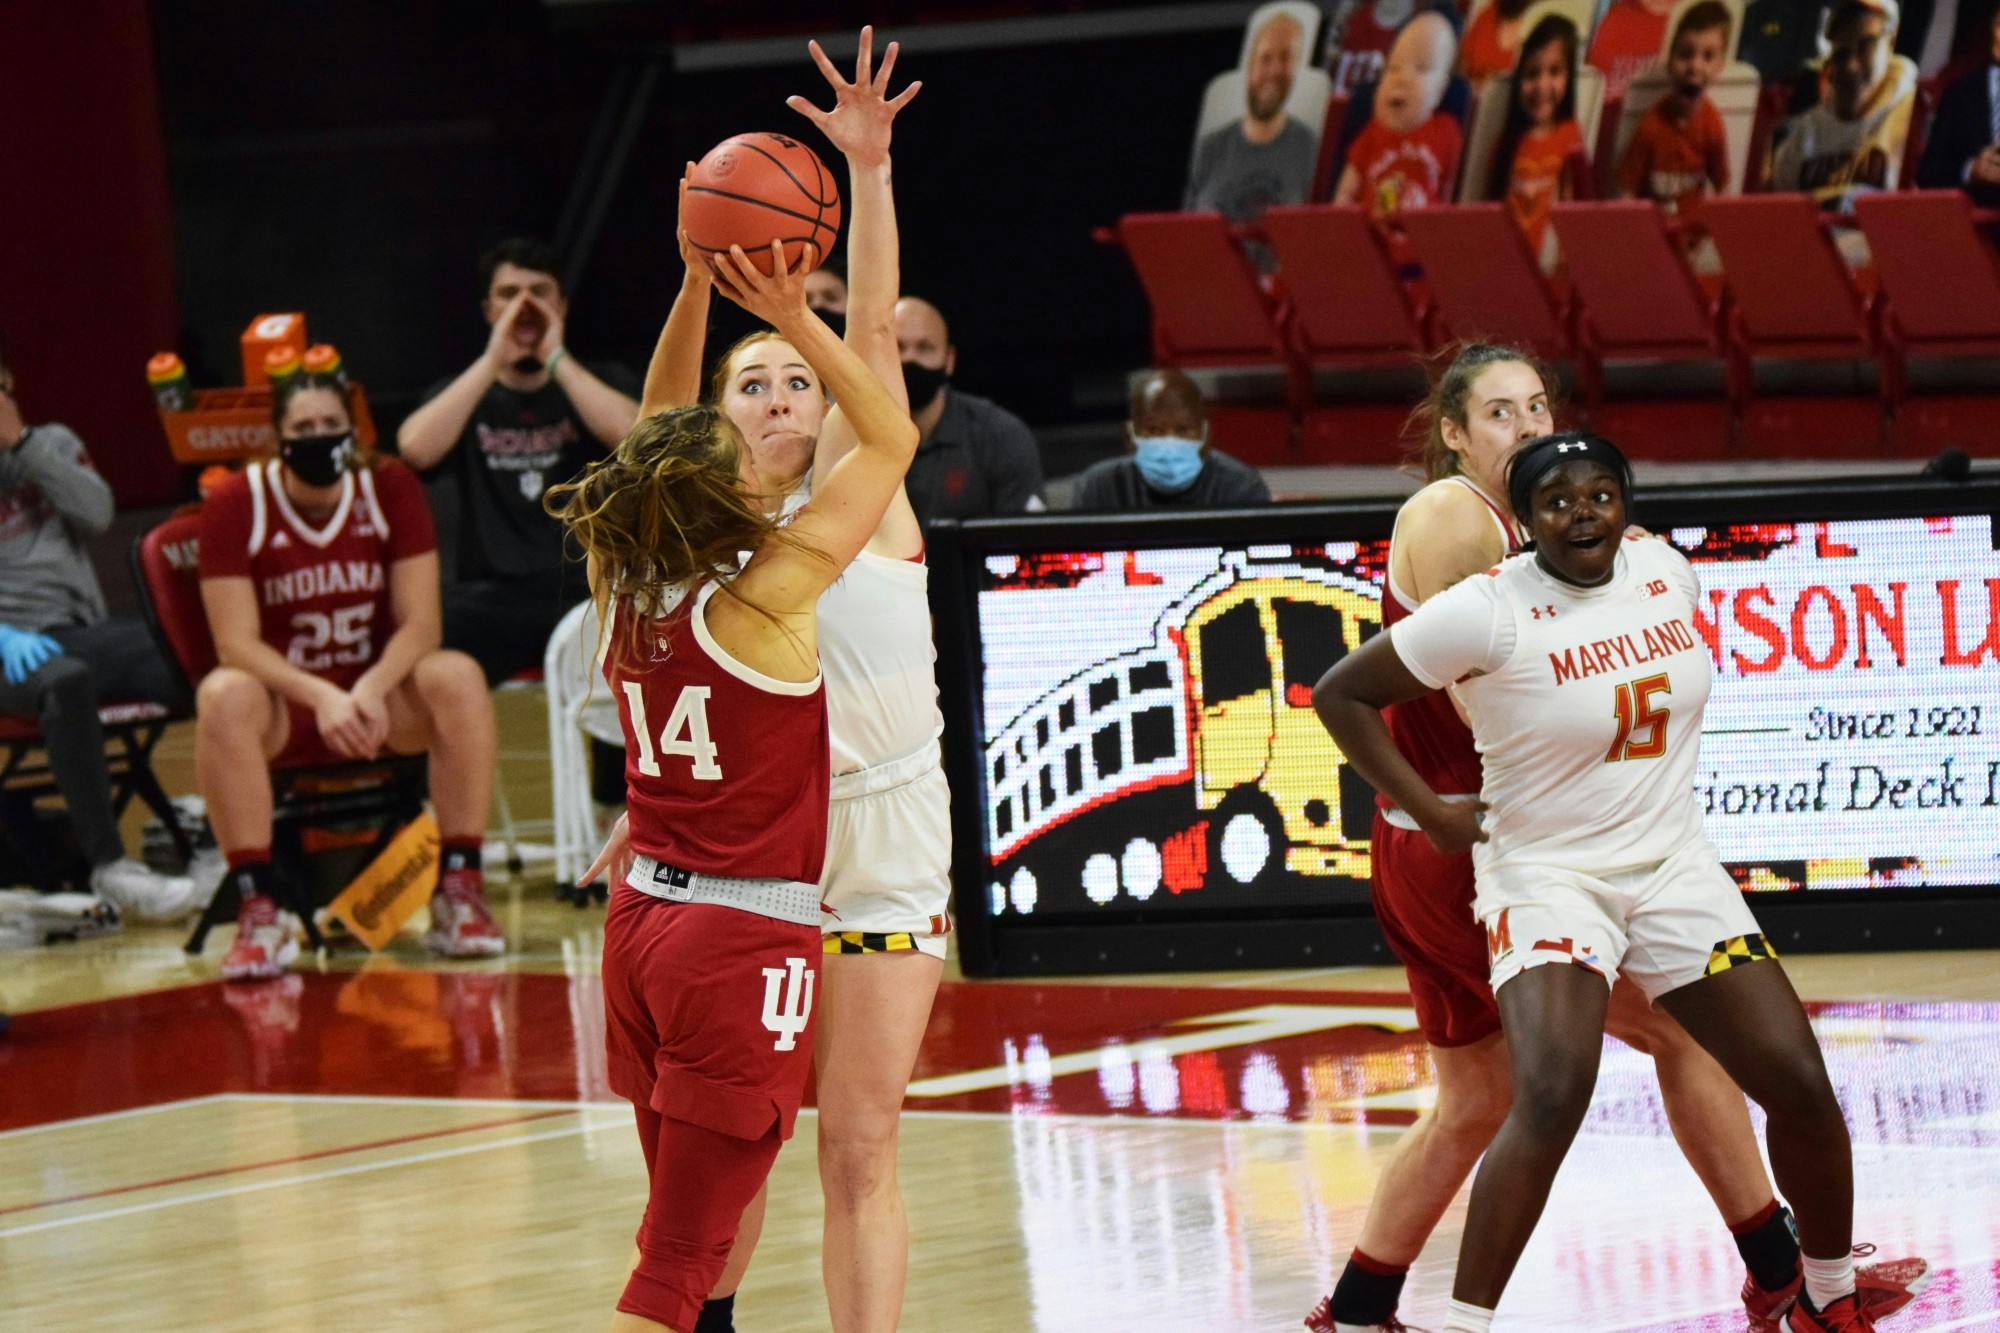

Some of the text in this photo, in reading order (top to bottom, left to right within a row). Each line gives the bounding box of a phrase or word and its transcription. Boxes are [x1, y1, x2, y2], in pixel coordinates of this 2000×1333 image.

[264, 560, 386, 606] INDIANA
[287, 601, 375, 670] 25
[1548, 618, 1695, 686] MARYLAND
[621, 680, 723, 780] 14
[1604, 672, 1671, 763] 15
[1805, 706, 1981, 740] Since 1921
[1693, 761, 1830, 815] ional
[1842, 757, 1964, 811] Deck
